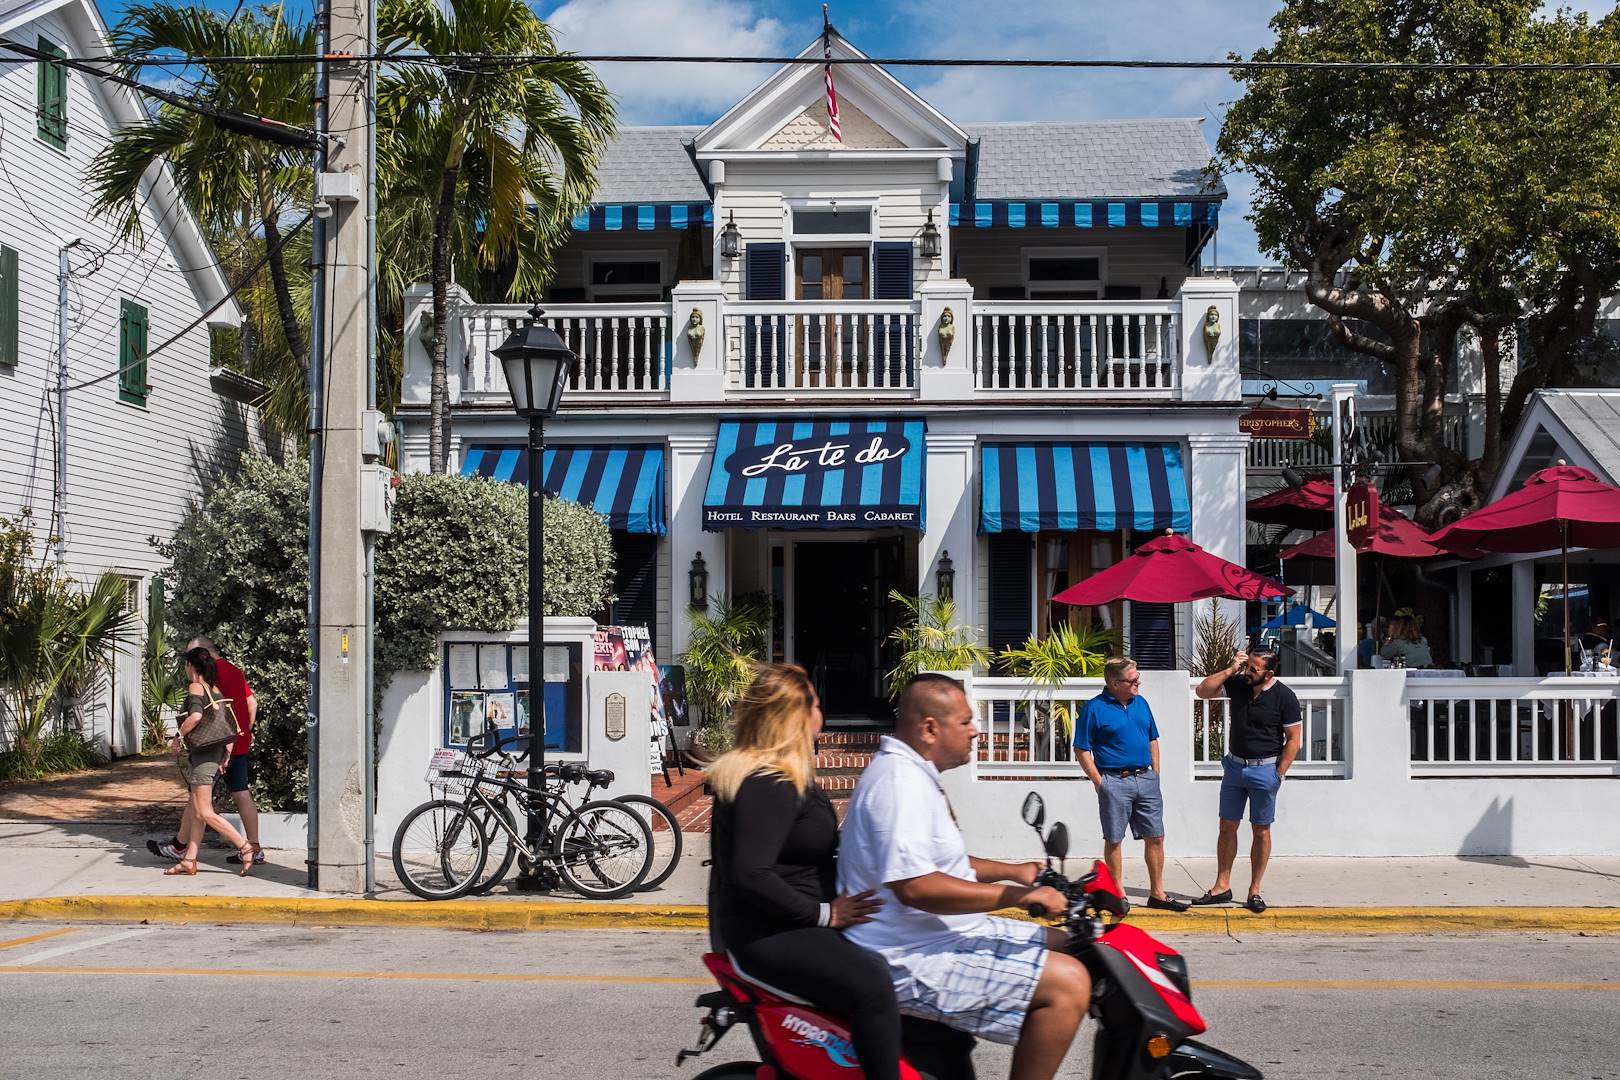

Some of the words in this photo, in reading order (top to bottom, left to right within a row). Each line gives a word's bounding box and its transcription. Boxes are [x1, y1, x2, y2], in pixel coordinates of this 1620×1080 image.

[1240, 419, 1303, 431] HRISTOPHER'S
[742, 443, 809, 477] La
[855, 436, 905, 464] da
